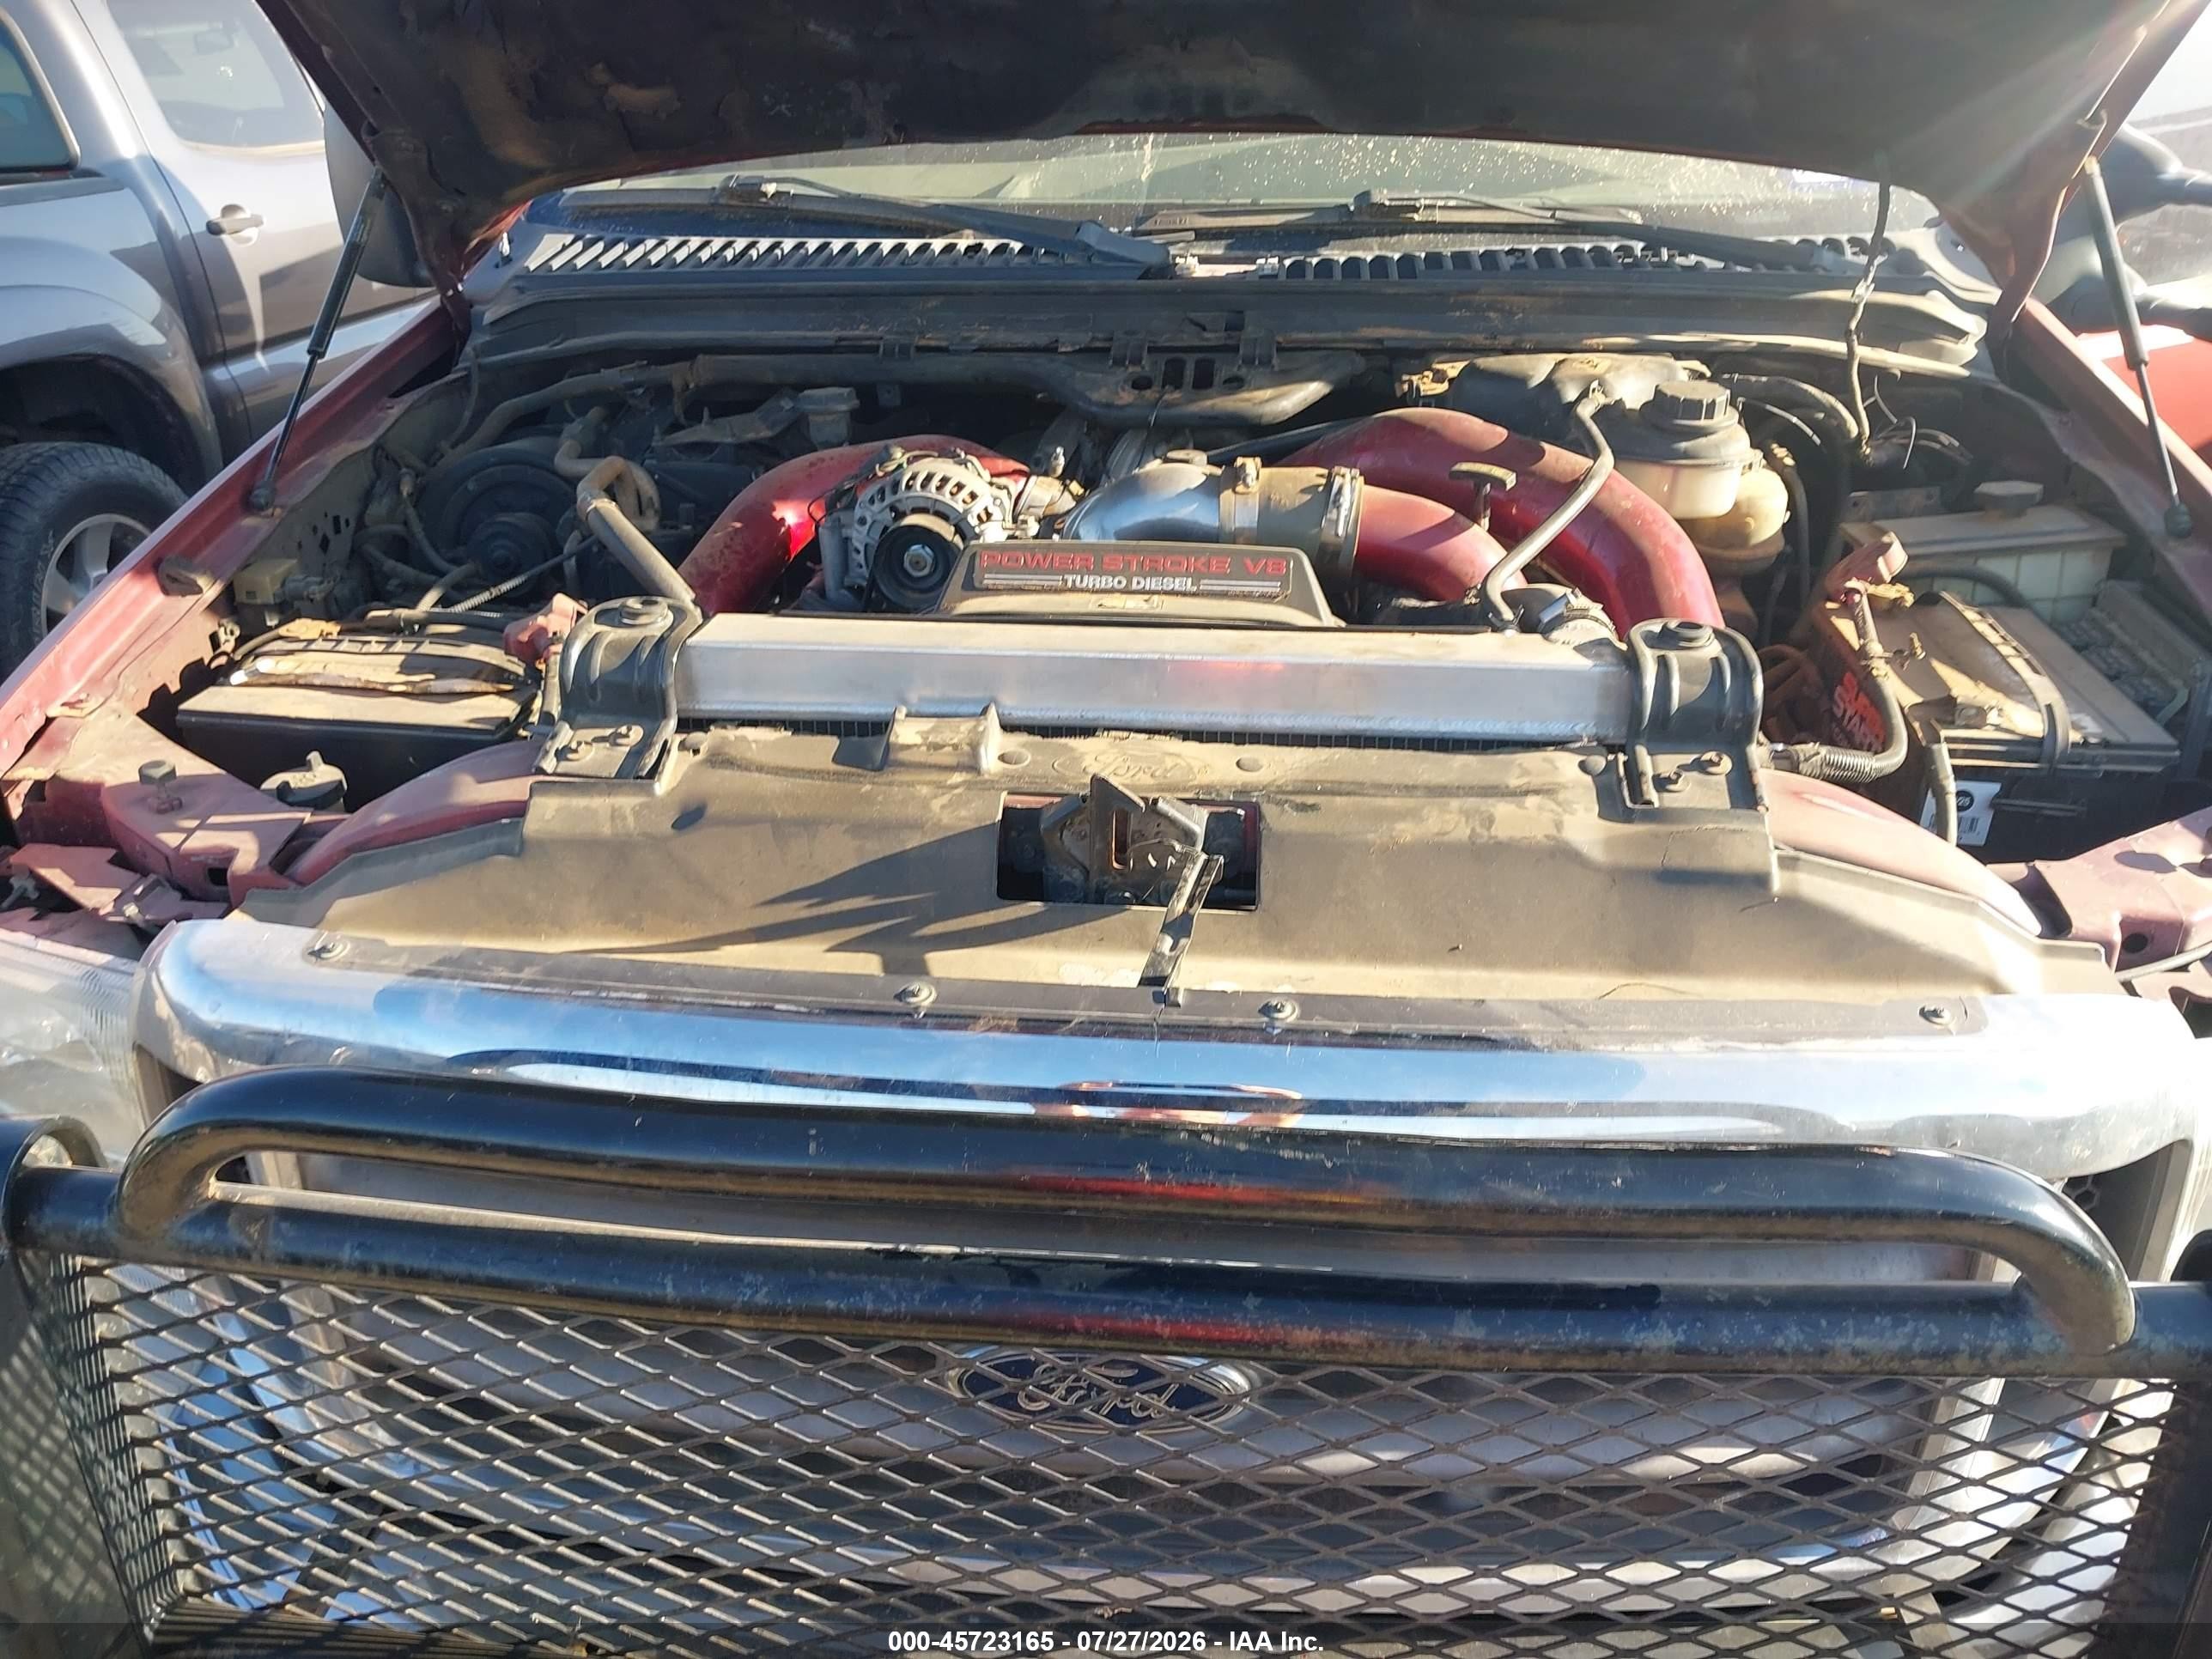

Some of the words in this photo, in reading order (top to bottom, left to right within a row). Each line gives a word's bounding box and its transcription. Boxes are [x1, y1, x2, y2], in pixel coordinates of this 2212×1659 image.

[980, 550, 1094, 570] POWER
[1103, 552, 1231, 574] STROKE
[1243, 557, 1287, 575] V8
[1063, 574, 1127, 590] TURBO
[1131, 576, 1197, 592] DIESEL
